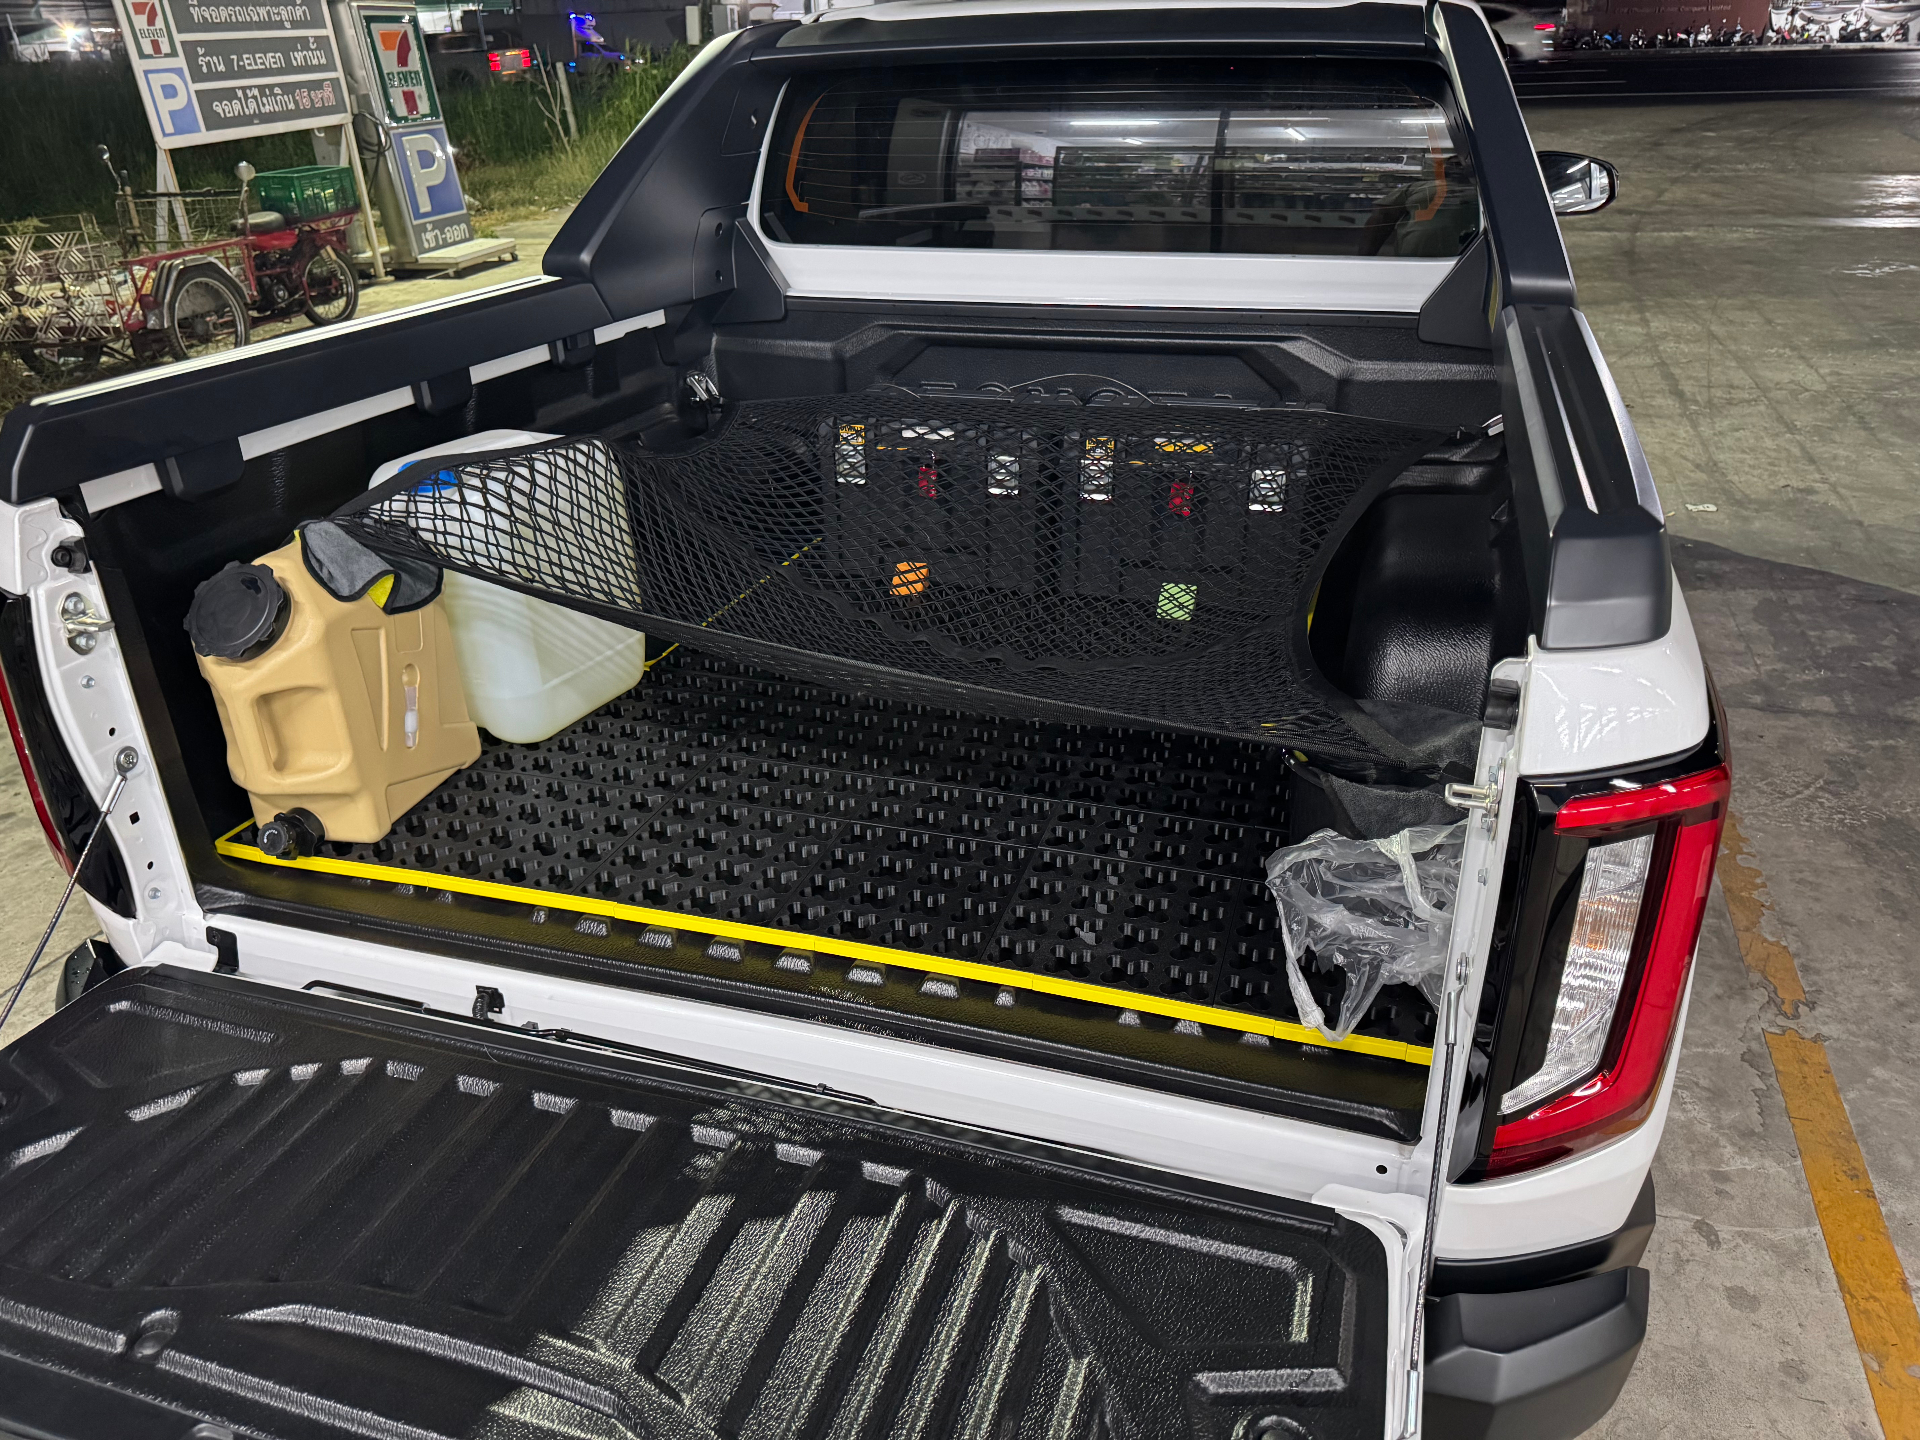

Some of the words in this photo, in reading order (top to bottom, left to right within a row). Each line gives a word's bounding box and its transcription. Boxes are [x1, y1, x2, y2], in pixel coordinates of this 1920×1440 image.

[188, 0, 311, 28] ทีจอดรถเฉพาะลูกคา
[198, 47, 226, 74] ร้าน
[290, 37, 327, 66] เท่านั้น
[148, 72, 188, 134] P
[212, 87, 296, 118] จอดได้ไม่เกิน
[295, 88, 311, 110] 15
[310, 81, 337, 108] นาที
[401, 133, 447, 213] P
[420, 223, 470, 249] เข้า-ออก
